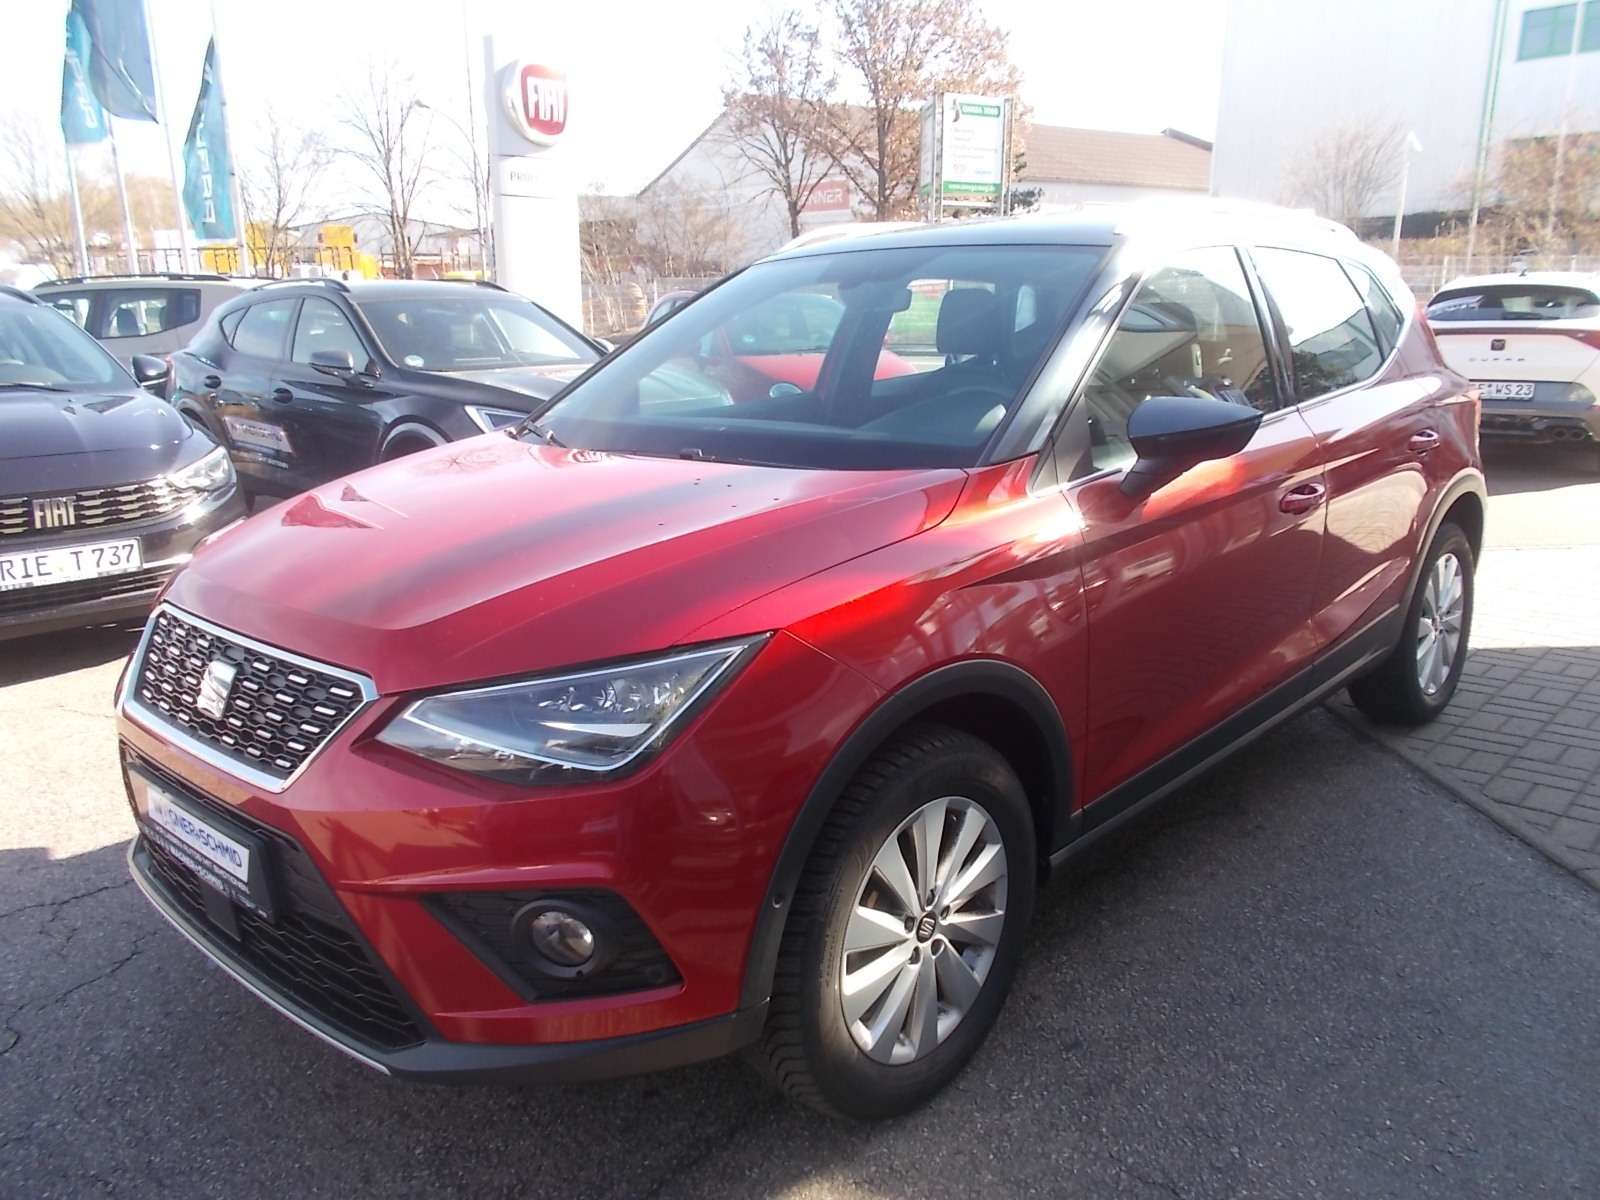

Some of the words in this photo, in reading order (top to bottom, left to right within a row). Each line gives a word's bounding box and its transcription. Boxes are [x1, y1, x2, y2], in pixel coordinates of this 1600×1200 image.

[526, 75, 566, 122] FIAT
[1514, 384, 1533, 396] 23
[32, 495, 77, 529] FIAT
[0, 555, 53, 580] RIE
[91, 544, 134, 568] 737
